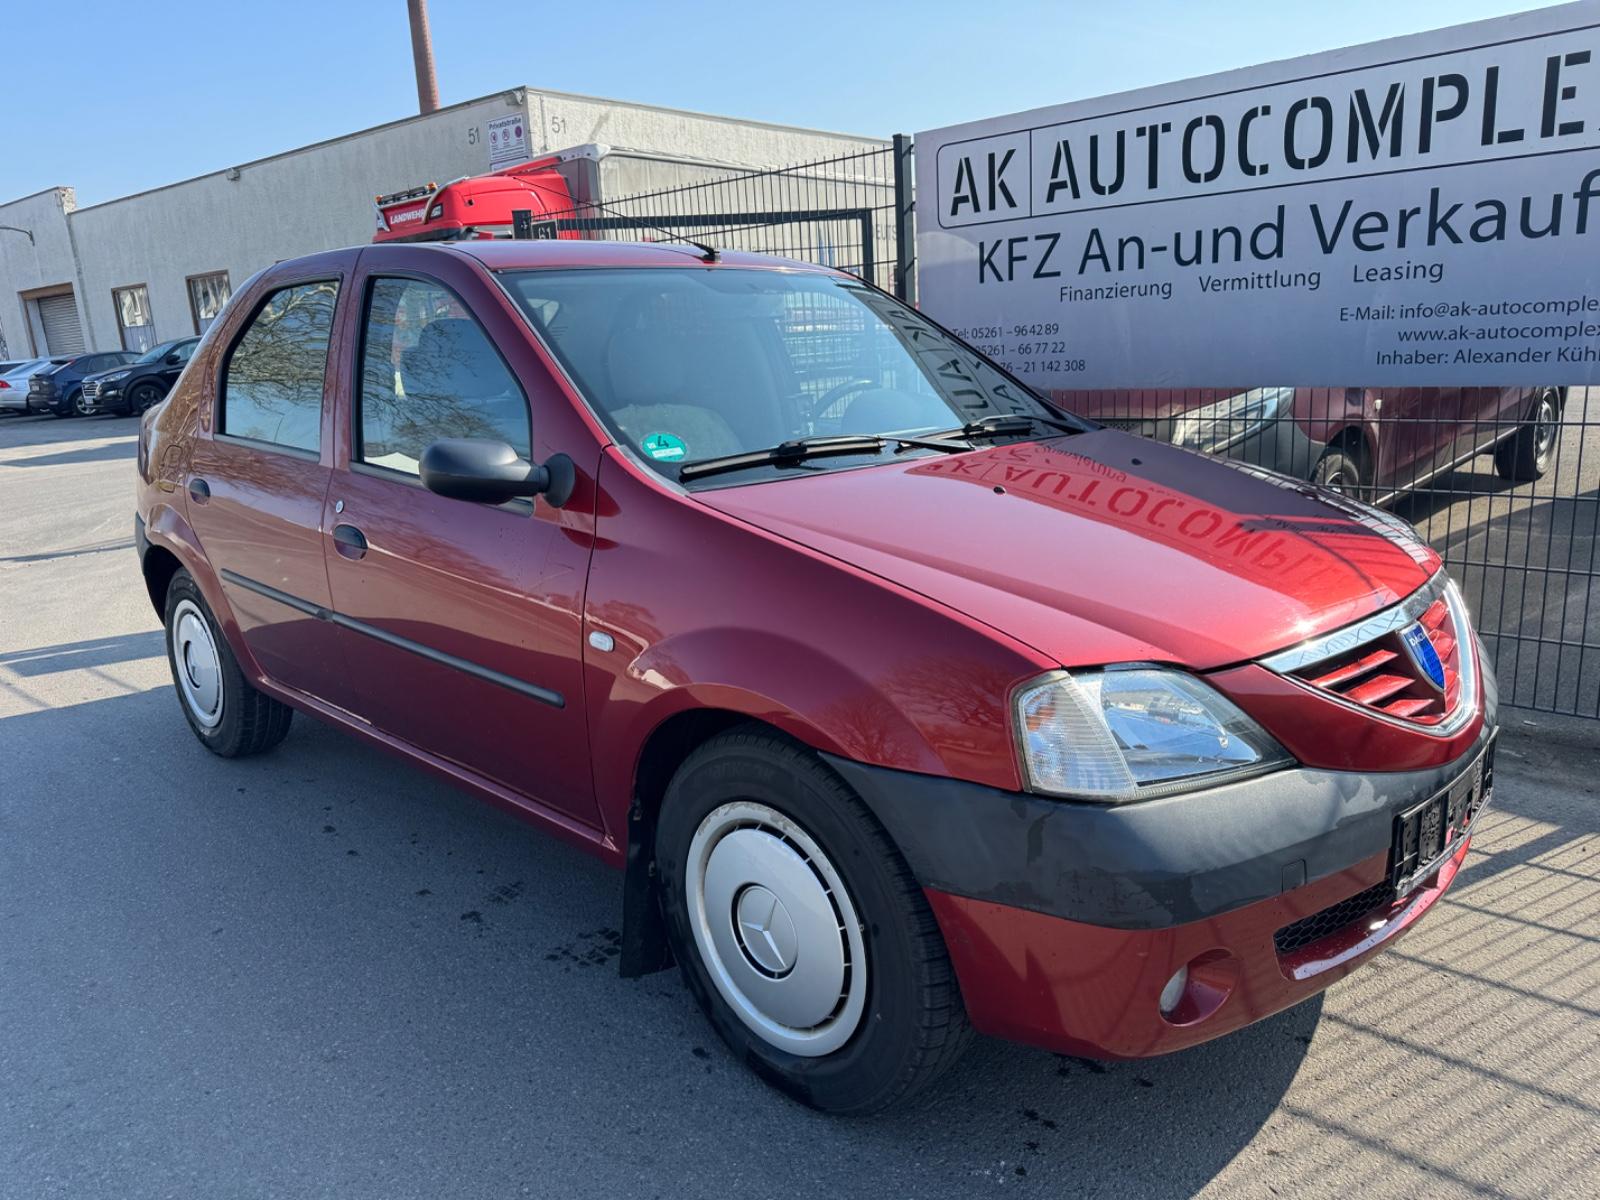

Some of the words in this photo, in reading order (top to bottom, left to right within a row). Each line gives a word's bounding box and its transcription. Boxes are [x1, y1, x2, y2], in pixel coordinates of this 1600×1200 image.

[551, 116, 567, 134] 51
[950, 148, 1018, 217] AK
[1046, 49, 1600, 204] AUTOCOMPLE
[468, 126, 480, 145] 51
[978, 232, 1062, 285] KFZ
[1078, 204, 1285, 275] An-und
[1309, 168, 1600, 255] Verkauf
[1060, 281, 1172, 302] Finanzierung
[1199, 270, 1321, 293] Vermittlung
[1353, 261, 1444, 283] Leasing
[1340, 304, 1395, 322] E-Mail:
[1400, 295, 1600, 320] info@ak-autocomple
[971, 326, 1003, 339] 05261
[1051, 341, 1066, 354] 22
[1376, 350, 1448, 365] Inhaber:
[1453, 348, 1551, 365] Alexander
[1557, 345, 1600, 363] Küh
[1023, 362, 1036, 373] 21
[1041, 360, 1061, 372] 142
[1064, 359, 1086, 372] 308
